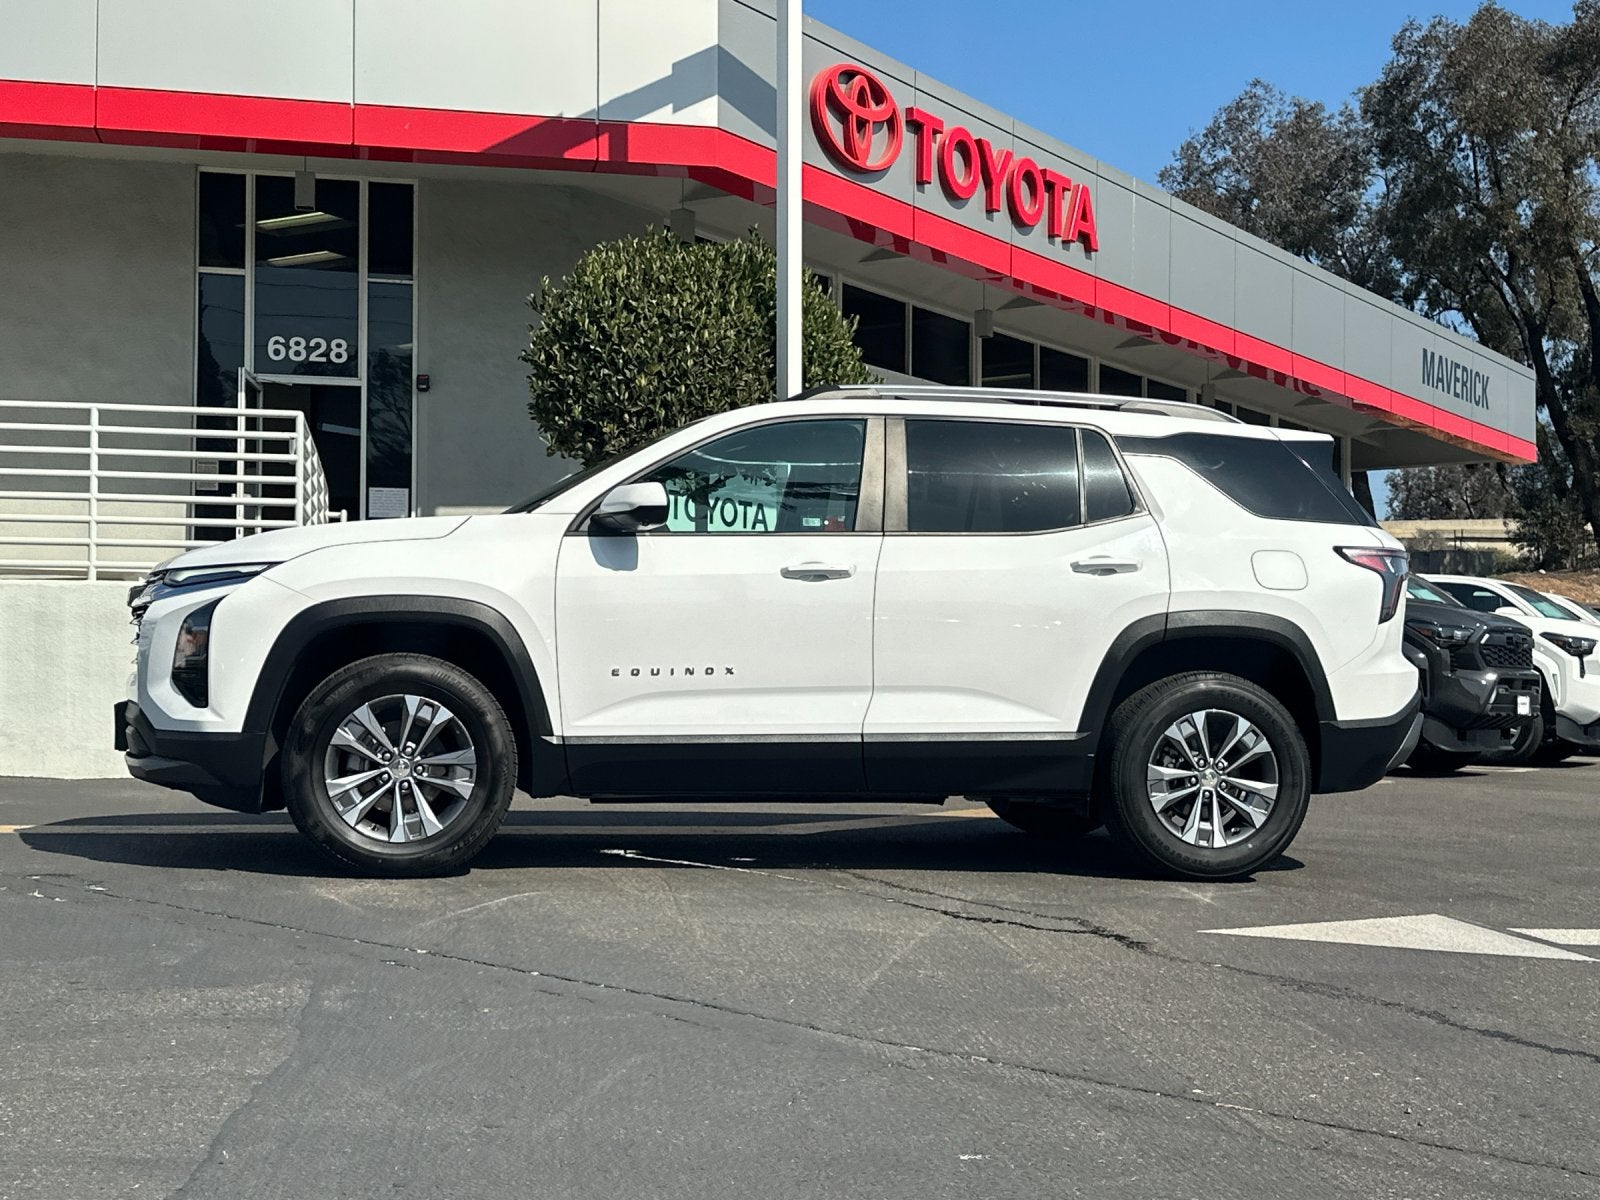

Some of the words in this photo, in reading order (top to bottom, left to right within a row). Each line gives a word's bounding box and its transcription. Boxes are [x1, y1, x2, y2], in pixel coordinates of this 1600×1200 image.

[905, 106, 1099, 252] TOYOTA
[267, 335, 348, 364] 6828
[1421, 348, 1490, 410] MAVERICK
[611, 666, 734, 677] EQUINOX
